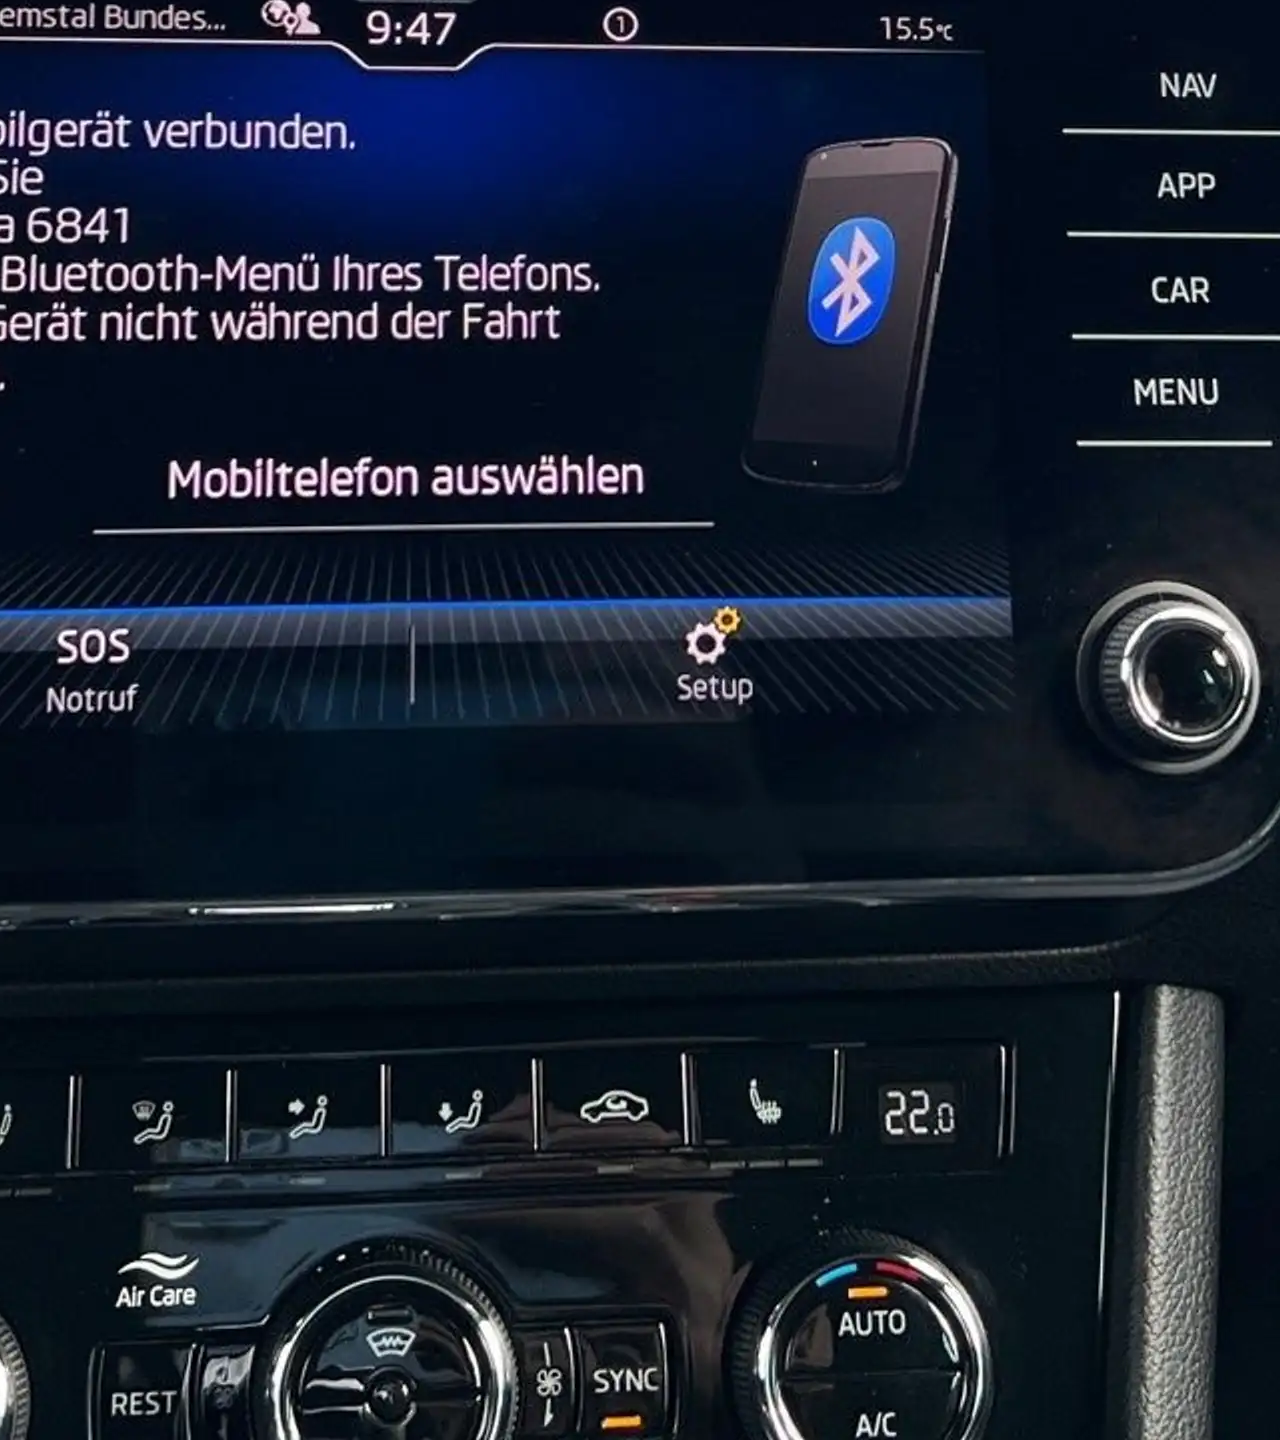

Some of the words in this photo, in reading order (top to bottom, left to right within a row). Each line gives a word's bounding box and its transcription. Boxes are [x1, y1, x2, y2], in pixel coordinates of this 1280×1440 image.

[103, 3, 226, 31] Bundes...
[366, 10, 457, 46] 9:47
[1160, 72, 1217, 99] NAV
[143, 111, 356, 150] verbunden.
[1157, 171, 1216, 199] APP
[27, 206, 128, 244] 6841
[0, 252, 320, 293] Bluetooth-Menü
[333, 253, 423, 292] Ihres
[433, 253, 600, 292] Telefons.
[1151, 276, 1210, 304] CAR
[99, 302, 199, 341] nicht
[210, 301, 379, 341] während
[390, 301, 452, 340] der
[463, 300, 561, 340] Fahrt
[1133, 377, 1219, 406] MENU
[168, 456, 419, 499] Mobiltelefon
[431, 454, 644, 496] auswählen
[57, 628, 130, 664] SOS
[47, 683, 139, 713] Notruf
[677, 674, 753, 705] Setup
[885, 1090, 955, 1135] 22.0
[115, 1285, 146, 1308] Air
[149, 1285, 197, 1307] Care
[838, 1309, 906, 1336] AUTO
[593, 1367, 659, 1393] SYNC
[111, 1391, 177, 1416] REST
[855, 1411, 897, 1438] A/C
